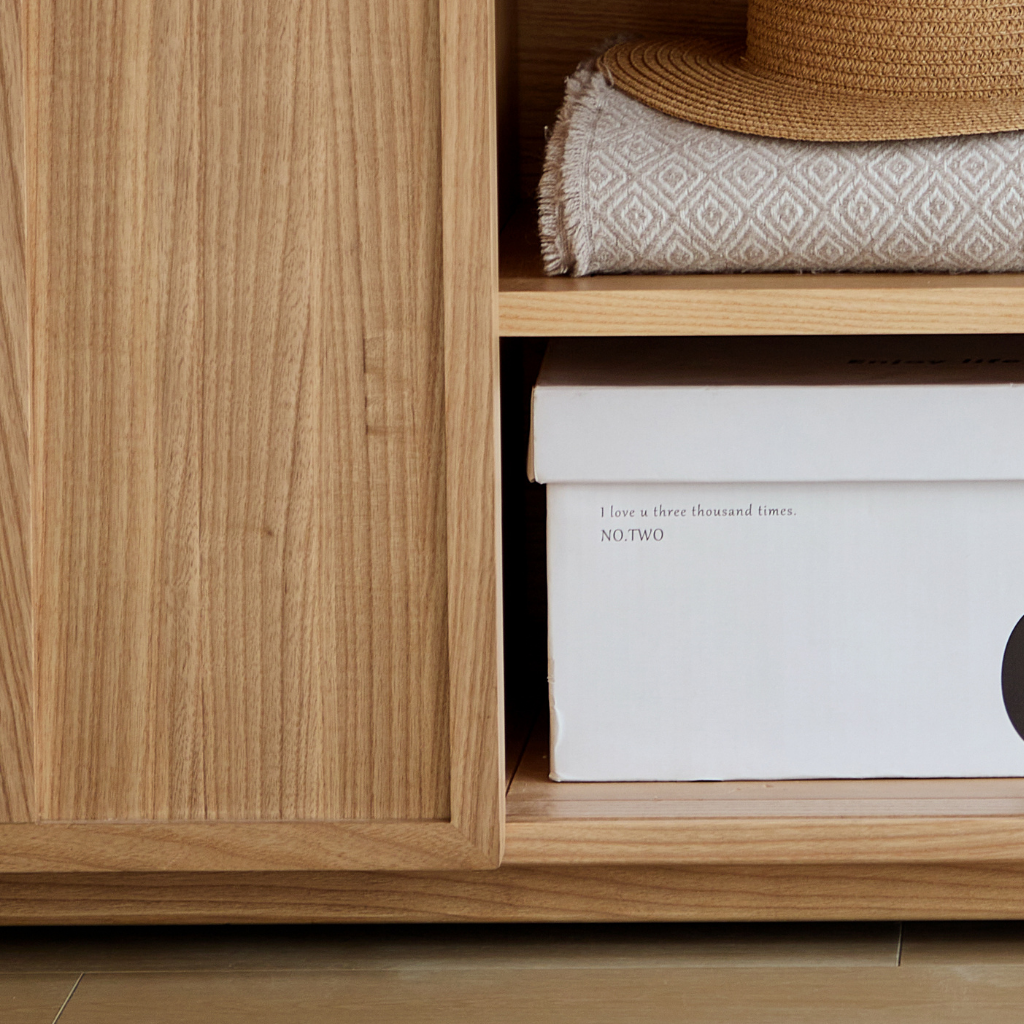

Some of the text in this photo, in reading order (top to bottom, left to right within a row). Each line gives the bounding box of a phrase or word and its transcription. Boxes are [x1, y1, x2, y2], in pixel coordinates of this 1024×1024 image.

[610, 505, 636, 518] love
[640, 509, 648, 518] u
[653, 504, 687, 518] three
[691, 503, 753, 517] thousand
[757, 505, 798, 517] times.
[600, 528, 665, 542] NO.TWO
